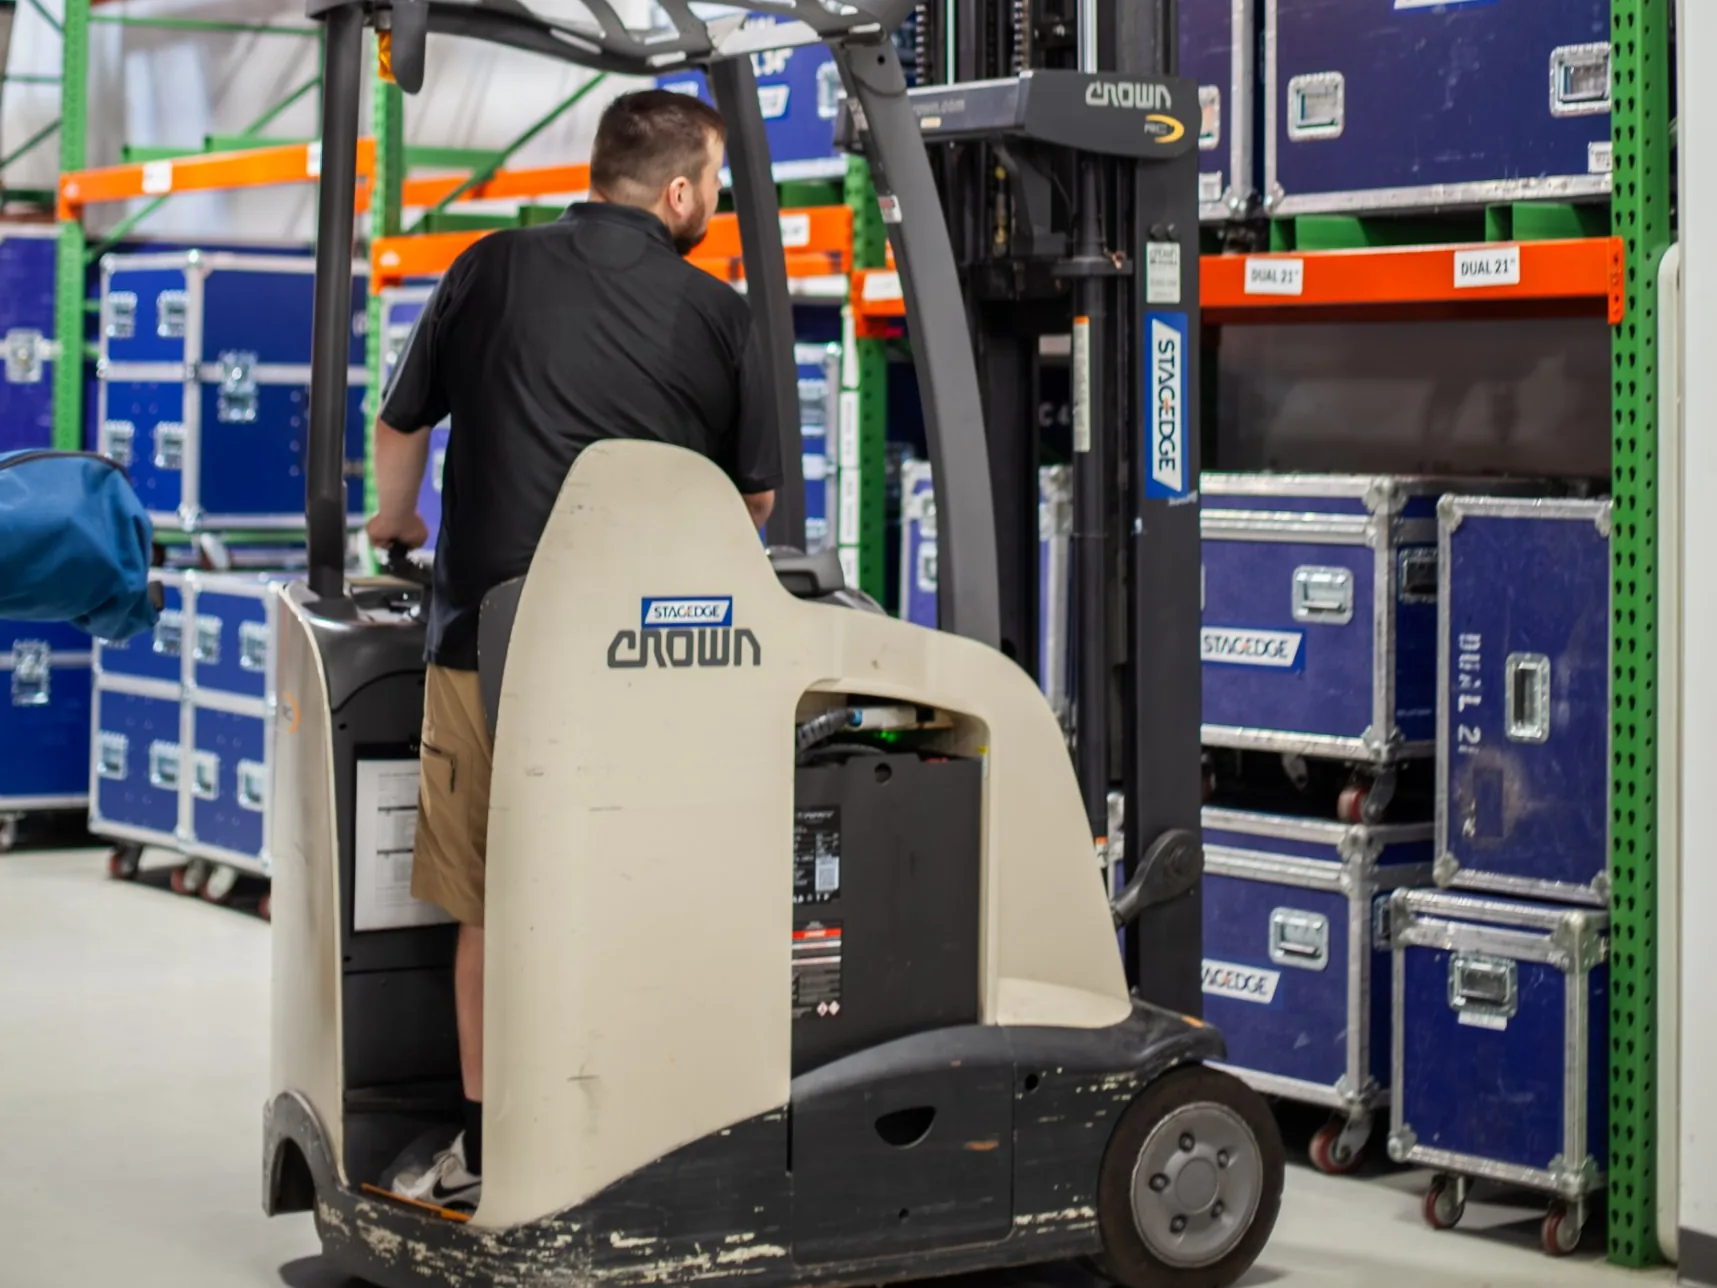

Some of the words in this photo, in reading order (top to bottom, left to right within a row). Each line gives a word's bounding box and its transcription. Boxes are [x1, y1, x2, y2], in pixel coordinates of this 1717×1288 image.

[1085, 80, 1172, 110] CROWN
[1251, 267, 1278, 284] DUAL
[1461, 258, 1492, 277] DUAL
[1158, 338, 1176, 471] STAGEDGE
[654, 605, 721, 619] STAGEDGE
[607, 629, 761, 668] CROWN
[1203, 633, 1290, 660] STAGEDGE
[1202, 966, 1270, 996] AGEDGE
